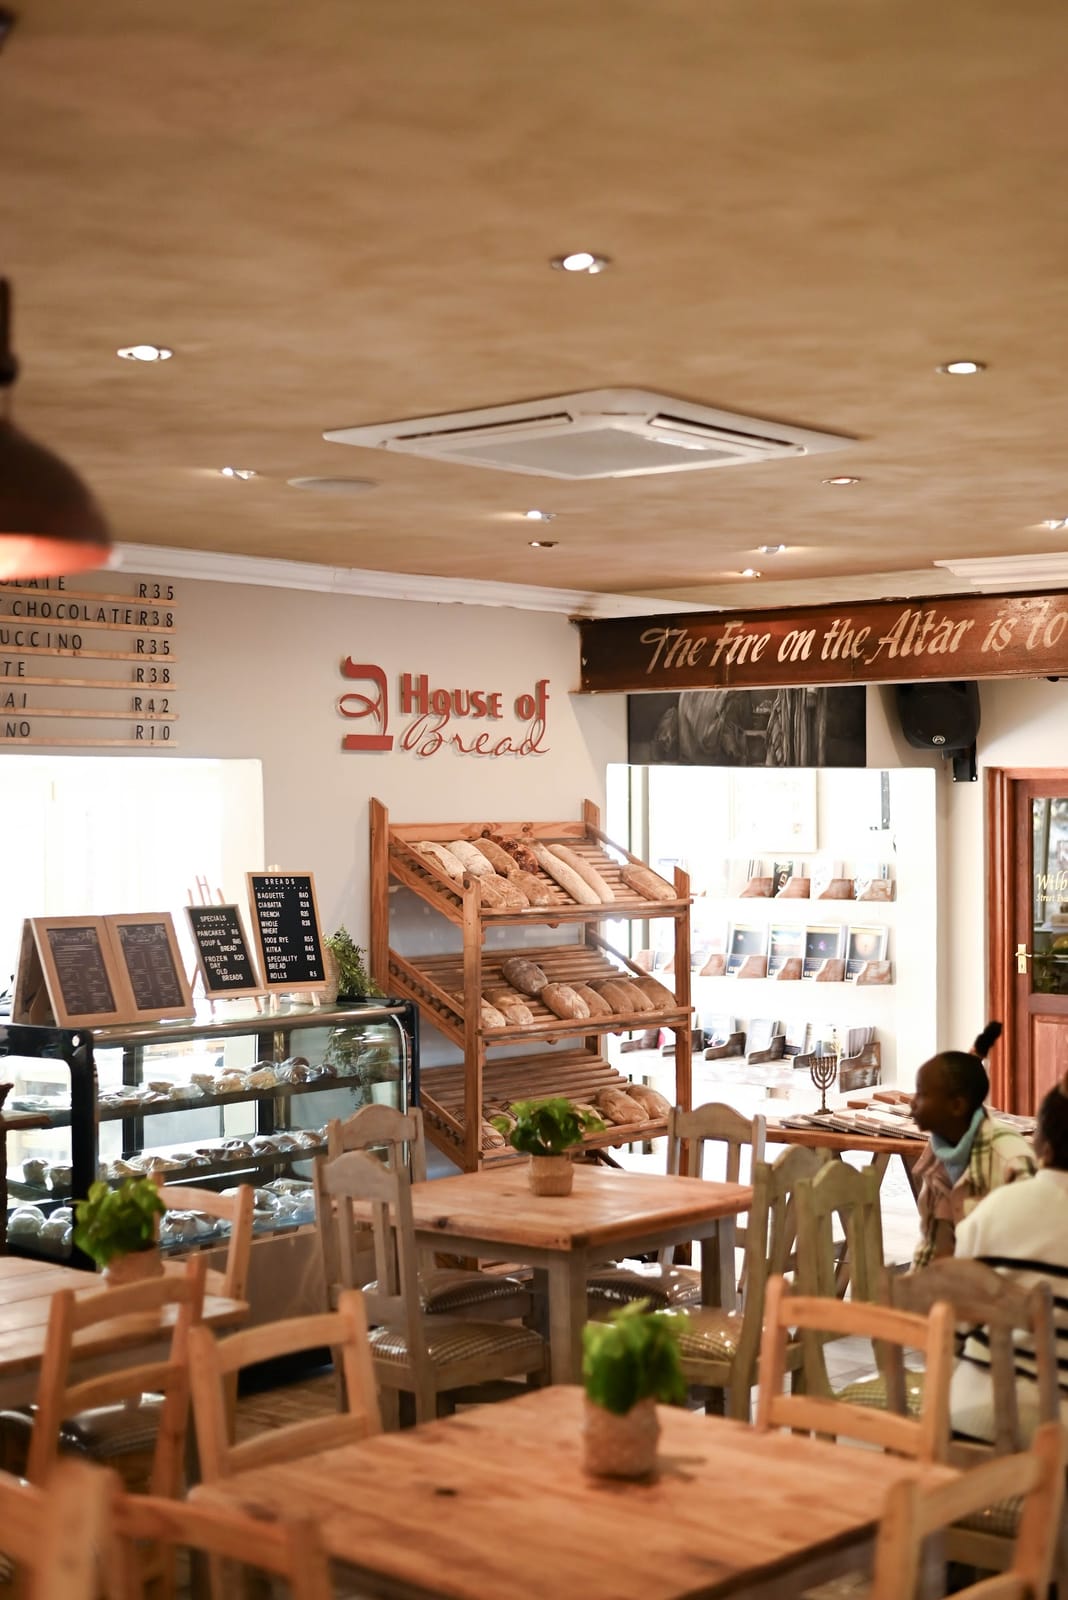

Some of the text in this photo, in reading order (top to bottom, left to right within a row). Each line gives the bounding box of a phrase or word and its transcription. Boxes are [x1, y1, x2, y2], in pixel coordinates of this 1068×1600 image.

[139, 583, 174, 600] R35
[12, 600, 174, 627] CHOCOLATE R38
[0, 629, 170, 655] UCCINO R35
[640, 602, 1068, 674] The Fire on the Altar is to
[3, 661, 170, 684] TE R38
[4, 692, 169, 713] AI R42
[5, 721, 170, 740] NO R10
[401, 711, 550, 757] Bread
[200, 914, 226, 922] SPECIALS
[204, 954, 228, 962] FROZEN
[267, 954, 298, 962] SPECIALITY
[222, 974, 244, 982] BREADS
[270, 972, 288, 980] ROLLS
